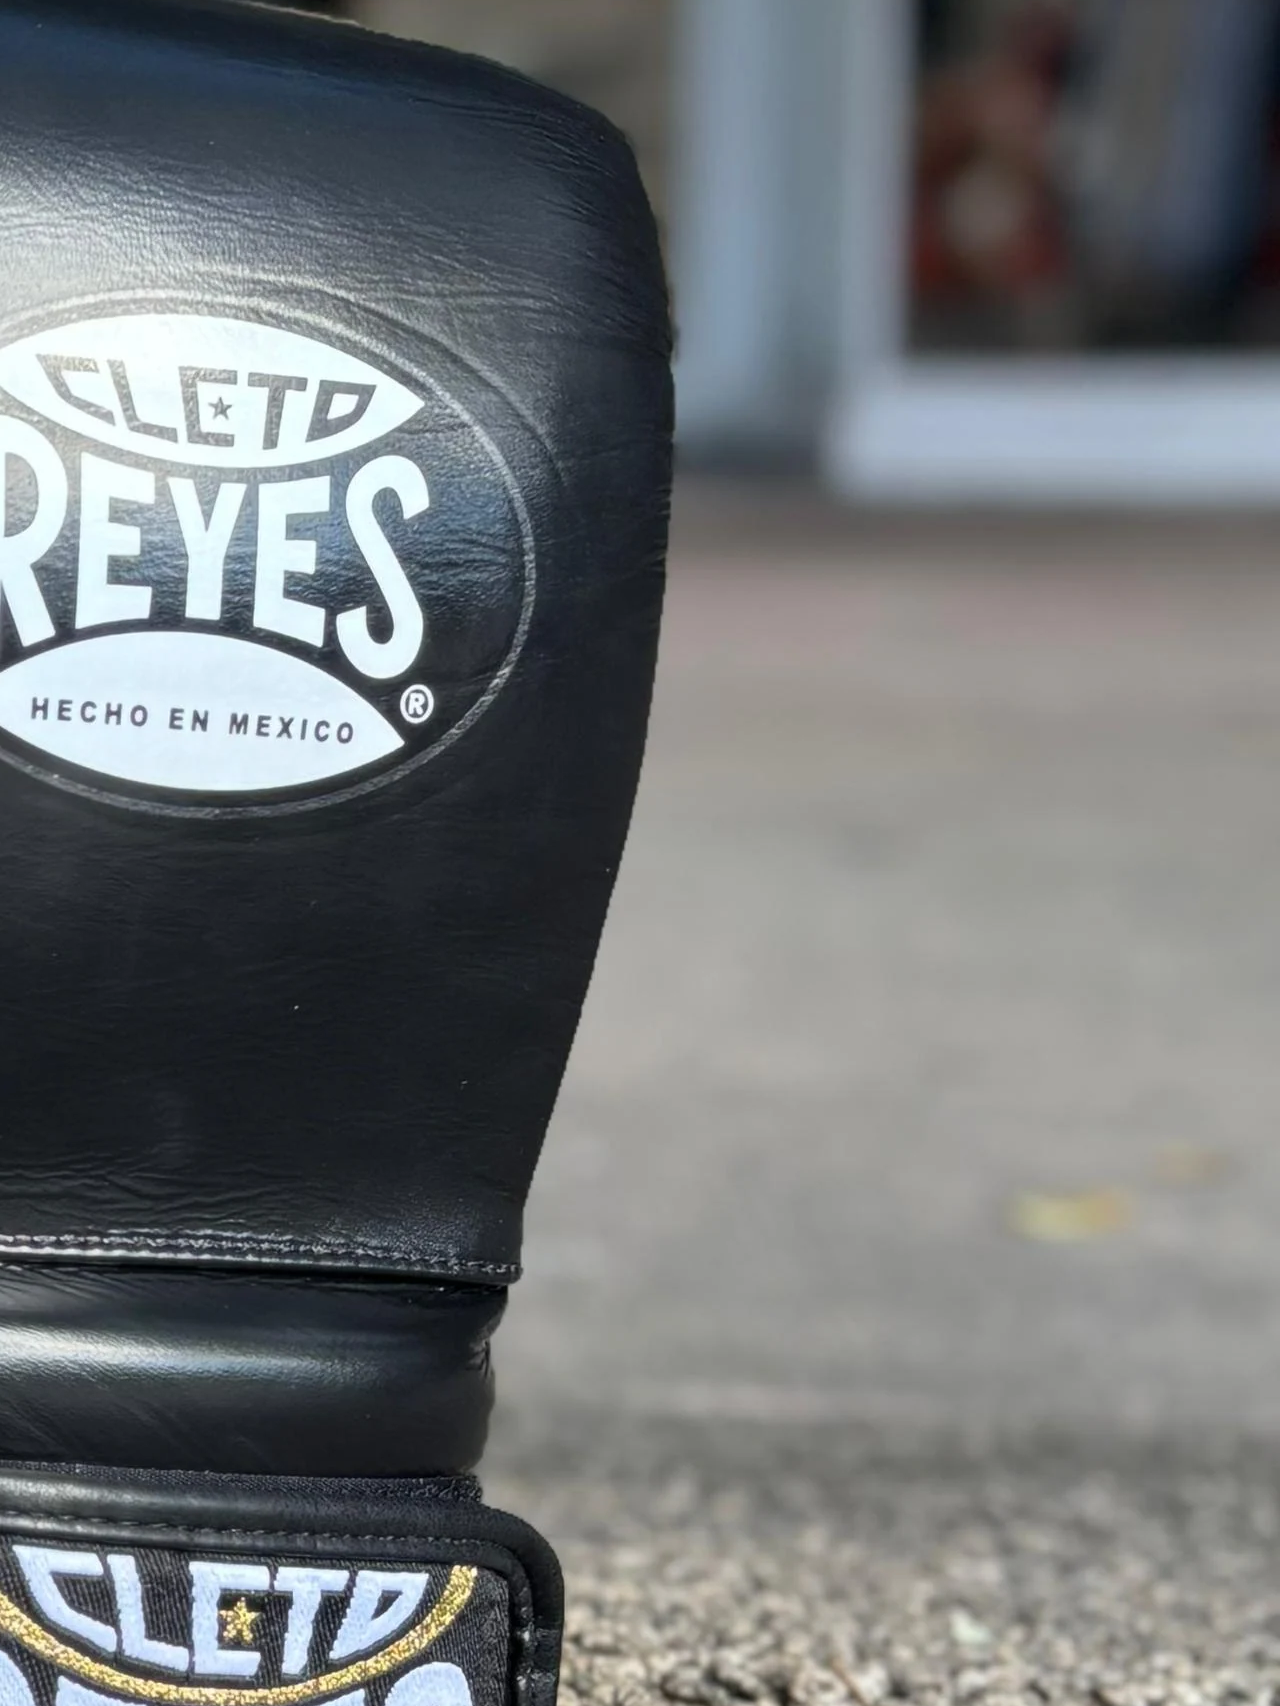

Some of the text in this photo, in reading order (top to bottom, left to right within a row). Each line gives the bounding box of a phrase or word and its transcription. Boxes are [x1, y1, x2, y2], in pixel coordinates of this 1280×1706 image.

[36, 353, 379, 451] CLETO
[30, 697, 355, 745] HECHO EN MEXICO
[12, 1544, 430, 1677] CLETO
